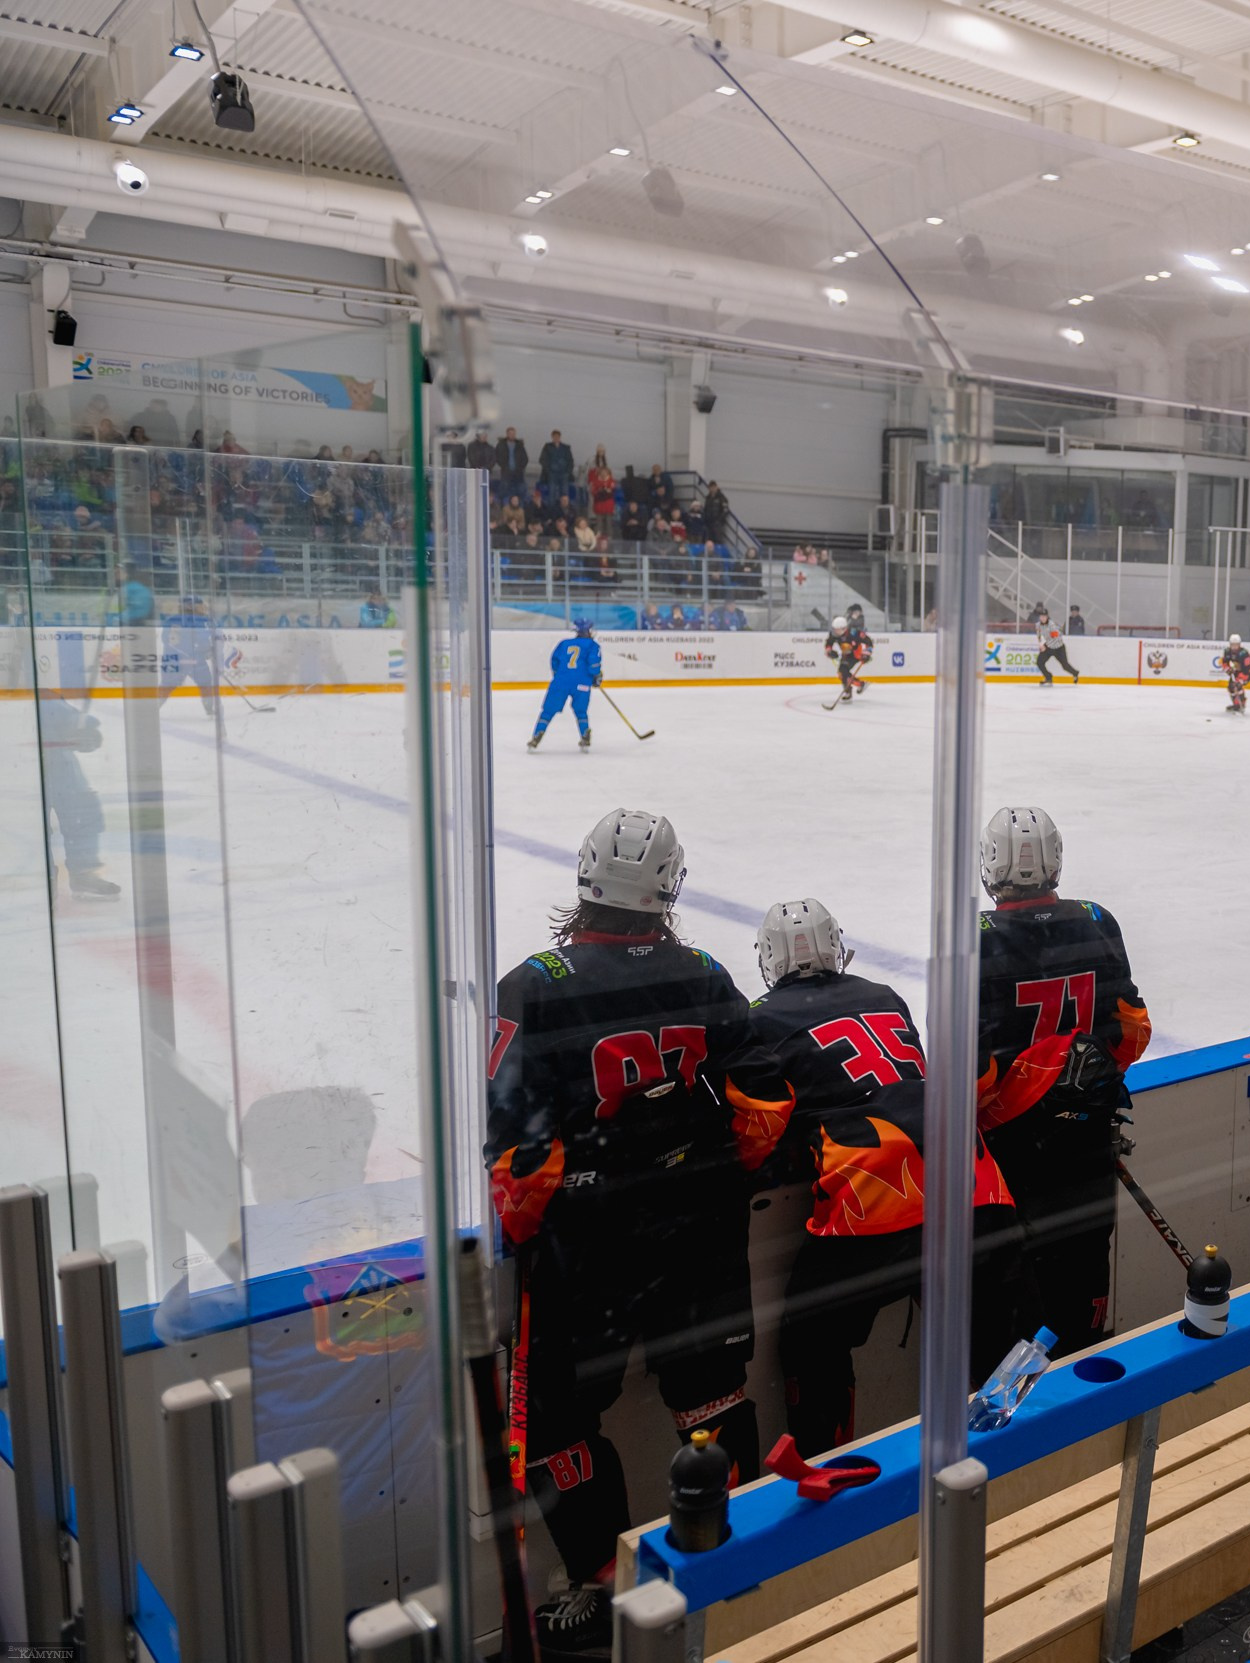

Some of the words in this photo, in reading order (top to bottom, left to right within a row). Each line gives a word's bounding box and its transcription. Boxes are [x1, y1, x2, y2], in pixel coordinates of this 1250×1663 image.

[211, 369, 226, 379] OF
[231, 371, 257, 382] ASIA
[232, 384, 252, 396] OF
[255, 387, 331, 404] VICTORIES
[567, 646, 581, 669] 7
[773, 652, 795, 660] РЦСС
[773, 660, 816, 668] КУЗБАССА
[1015, 970, 1096, 1047] 71
[807, 1011, 927, 1087] 35
[546, 1439, 594, 1492] 87
